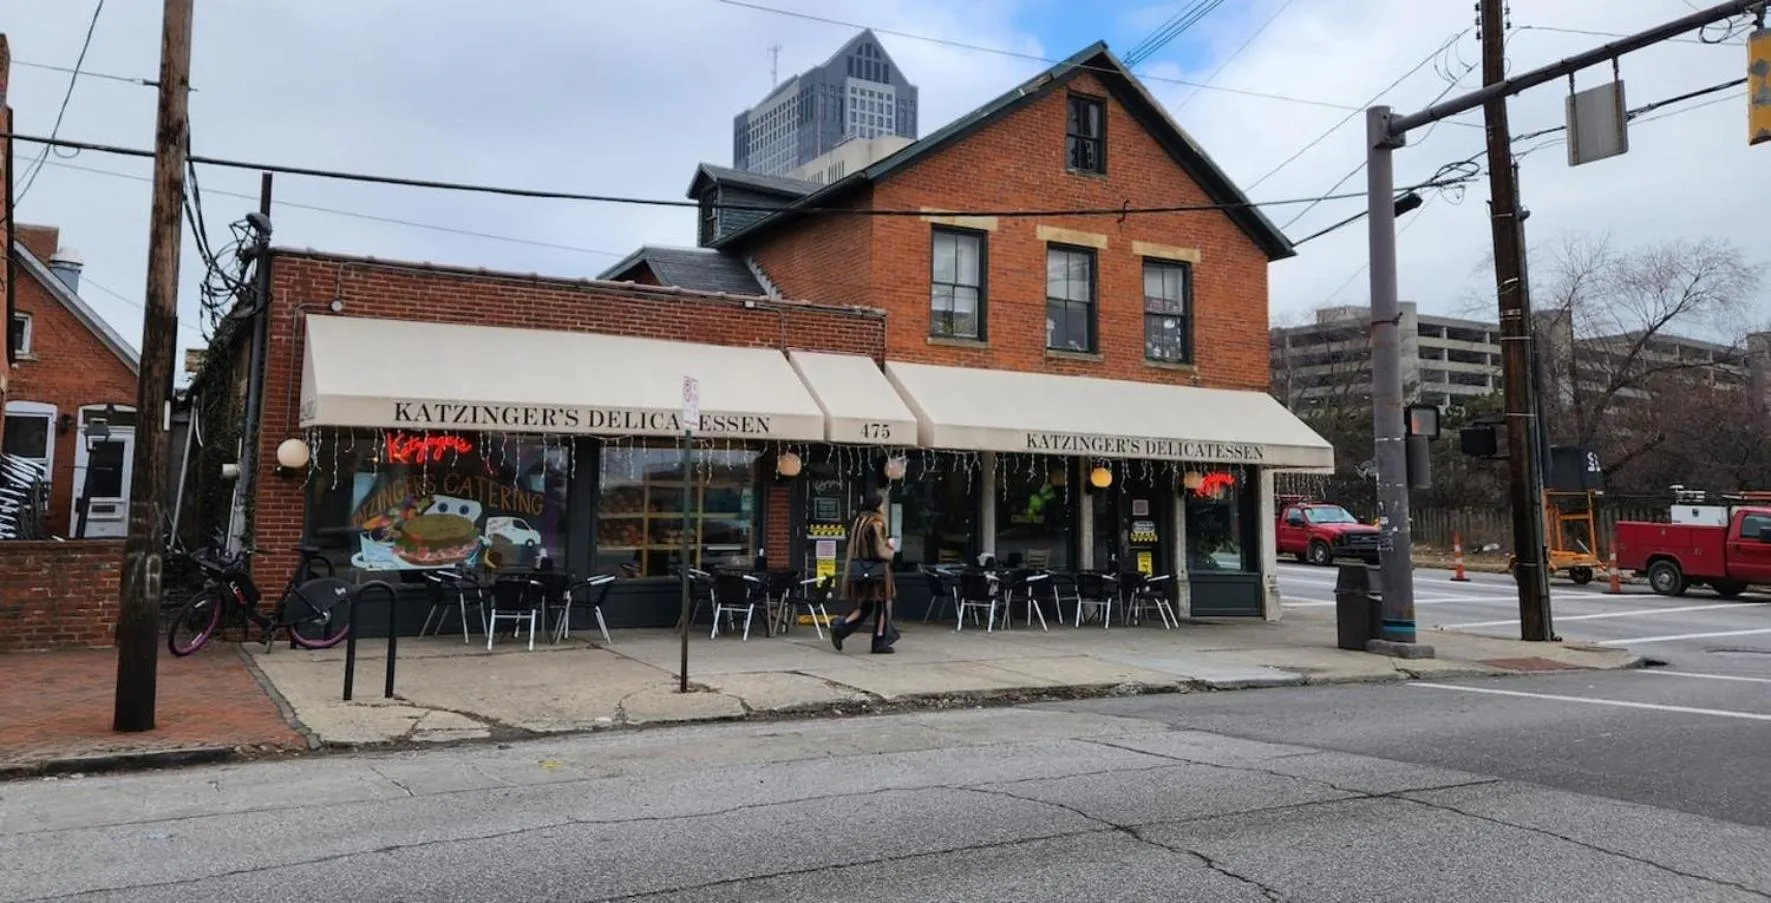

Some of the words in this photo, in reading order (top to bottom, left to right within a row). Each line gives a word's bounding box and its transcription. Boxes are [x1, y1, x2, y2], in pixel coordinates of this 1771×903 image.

[394, 402, 579, 427] KATZINGER'S
[588, 409, 771, 434] DELICAESSEN
[859, 423, 891, 440] 475
[1026, 433, 1140, 453] KATZINGER'S
[1145, 437, 1264, 460] DELICATESSEN
[443, 473, 544, 514] CATERING
